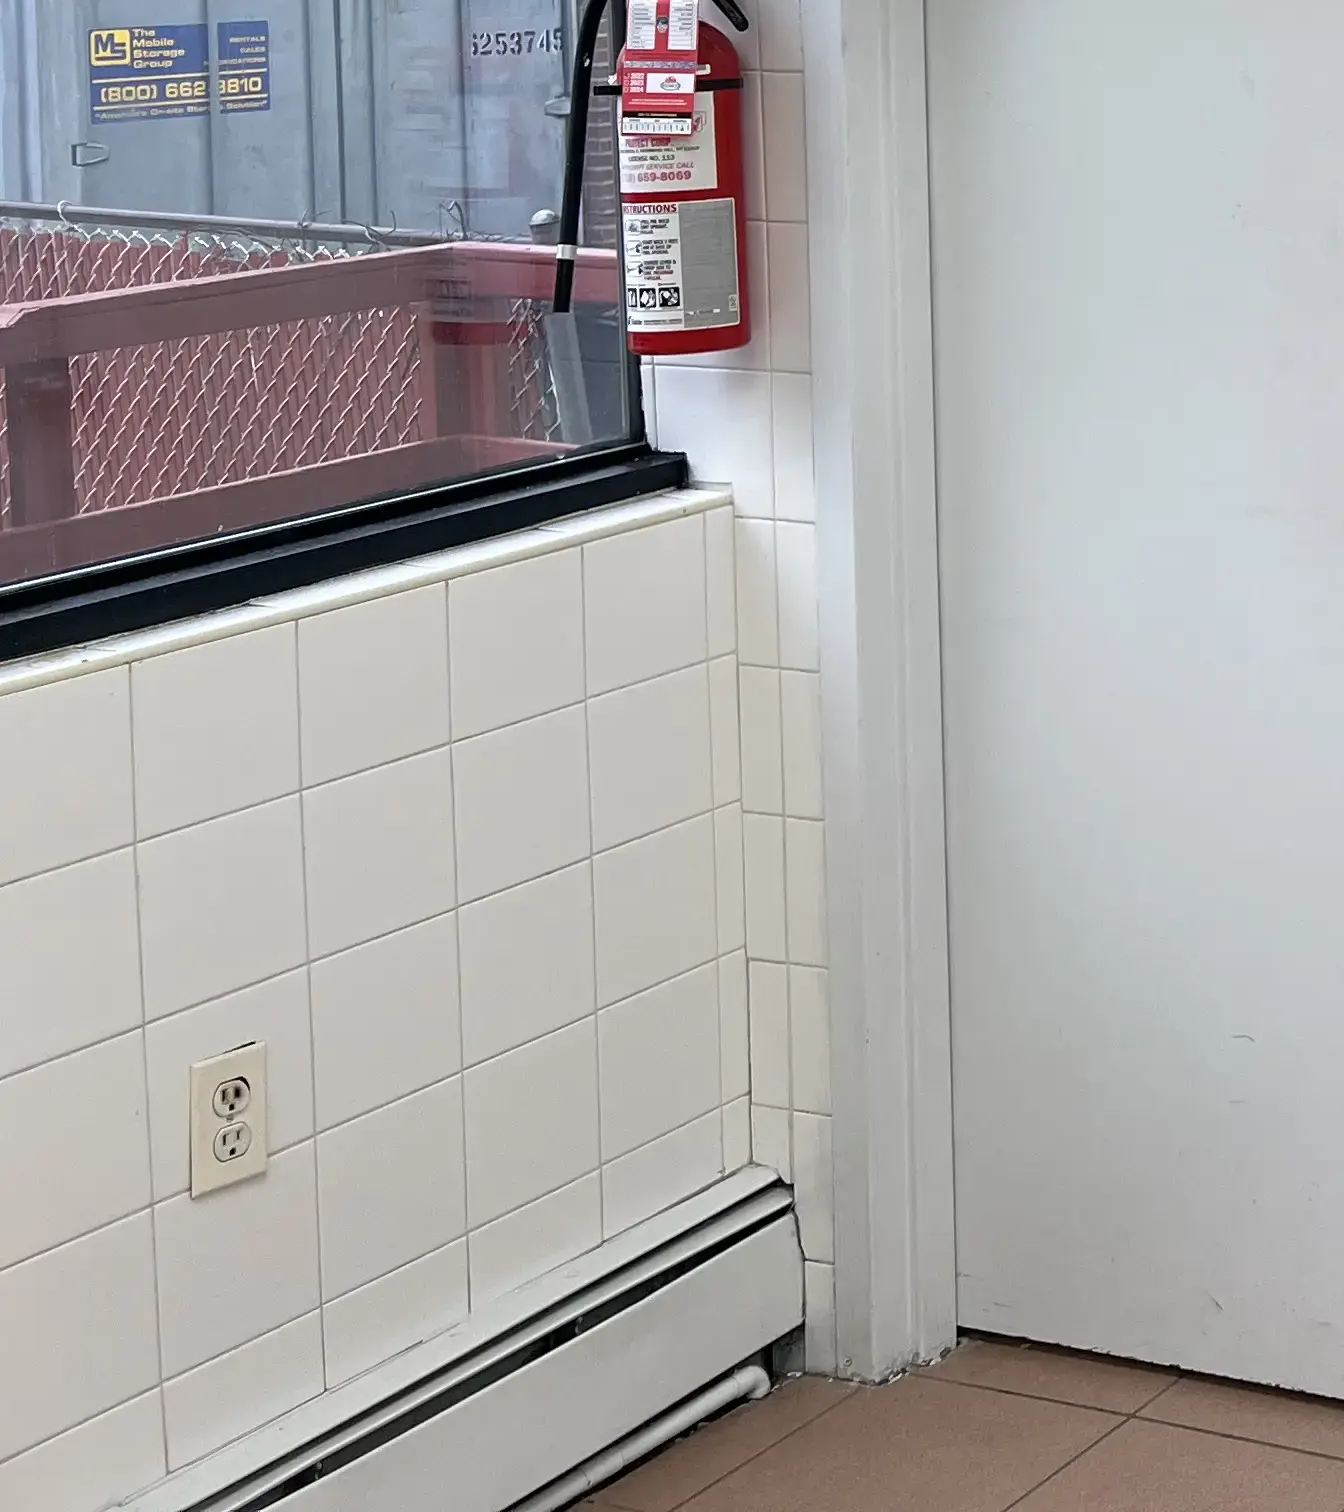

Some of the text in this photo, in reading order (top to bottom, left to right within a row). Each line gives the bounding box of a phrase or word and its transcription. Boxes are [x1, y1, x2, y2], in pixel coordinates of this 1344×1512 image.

[132, 28, 155, 38] The
[132, 38, 174, 47] Mobile
[133, 48, 185, 59] Storage
[133, 60, 173, 69] Group
[101, 84, 157, 103] (800)
[637, 170, 692, 182] 659-8069
